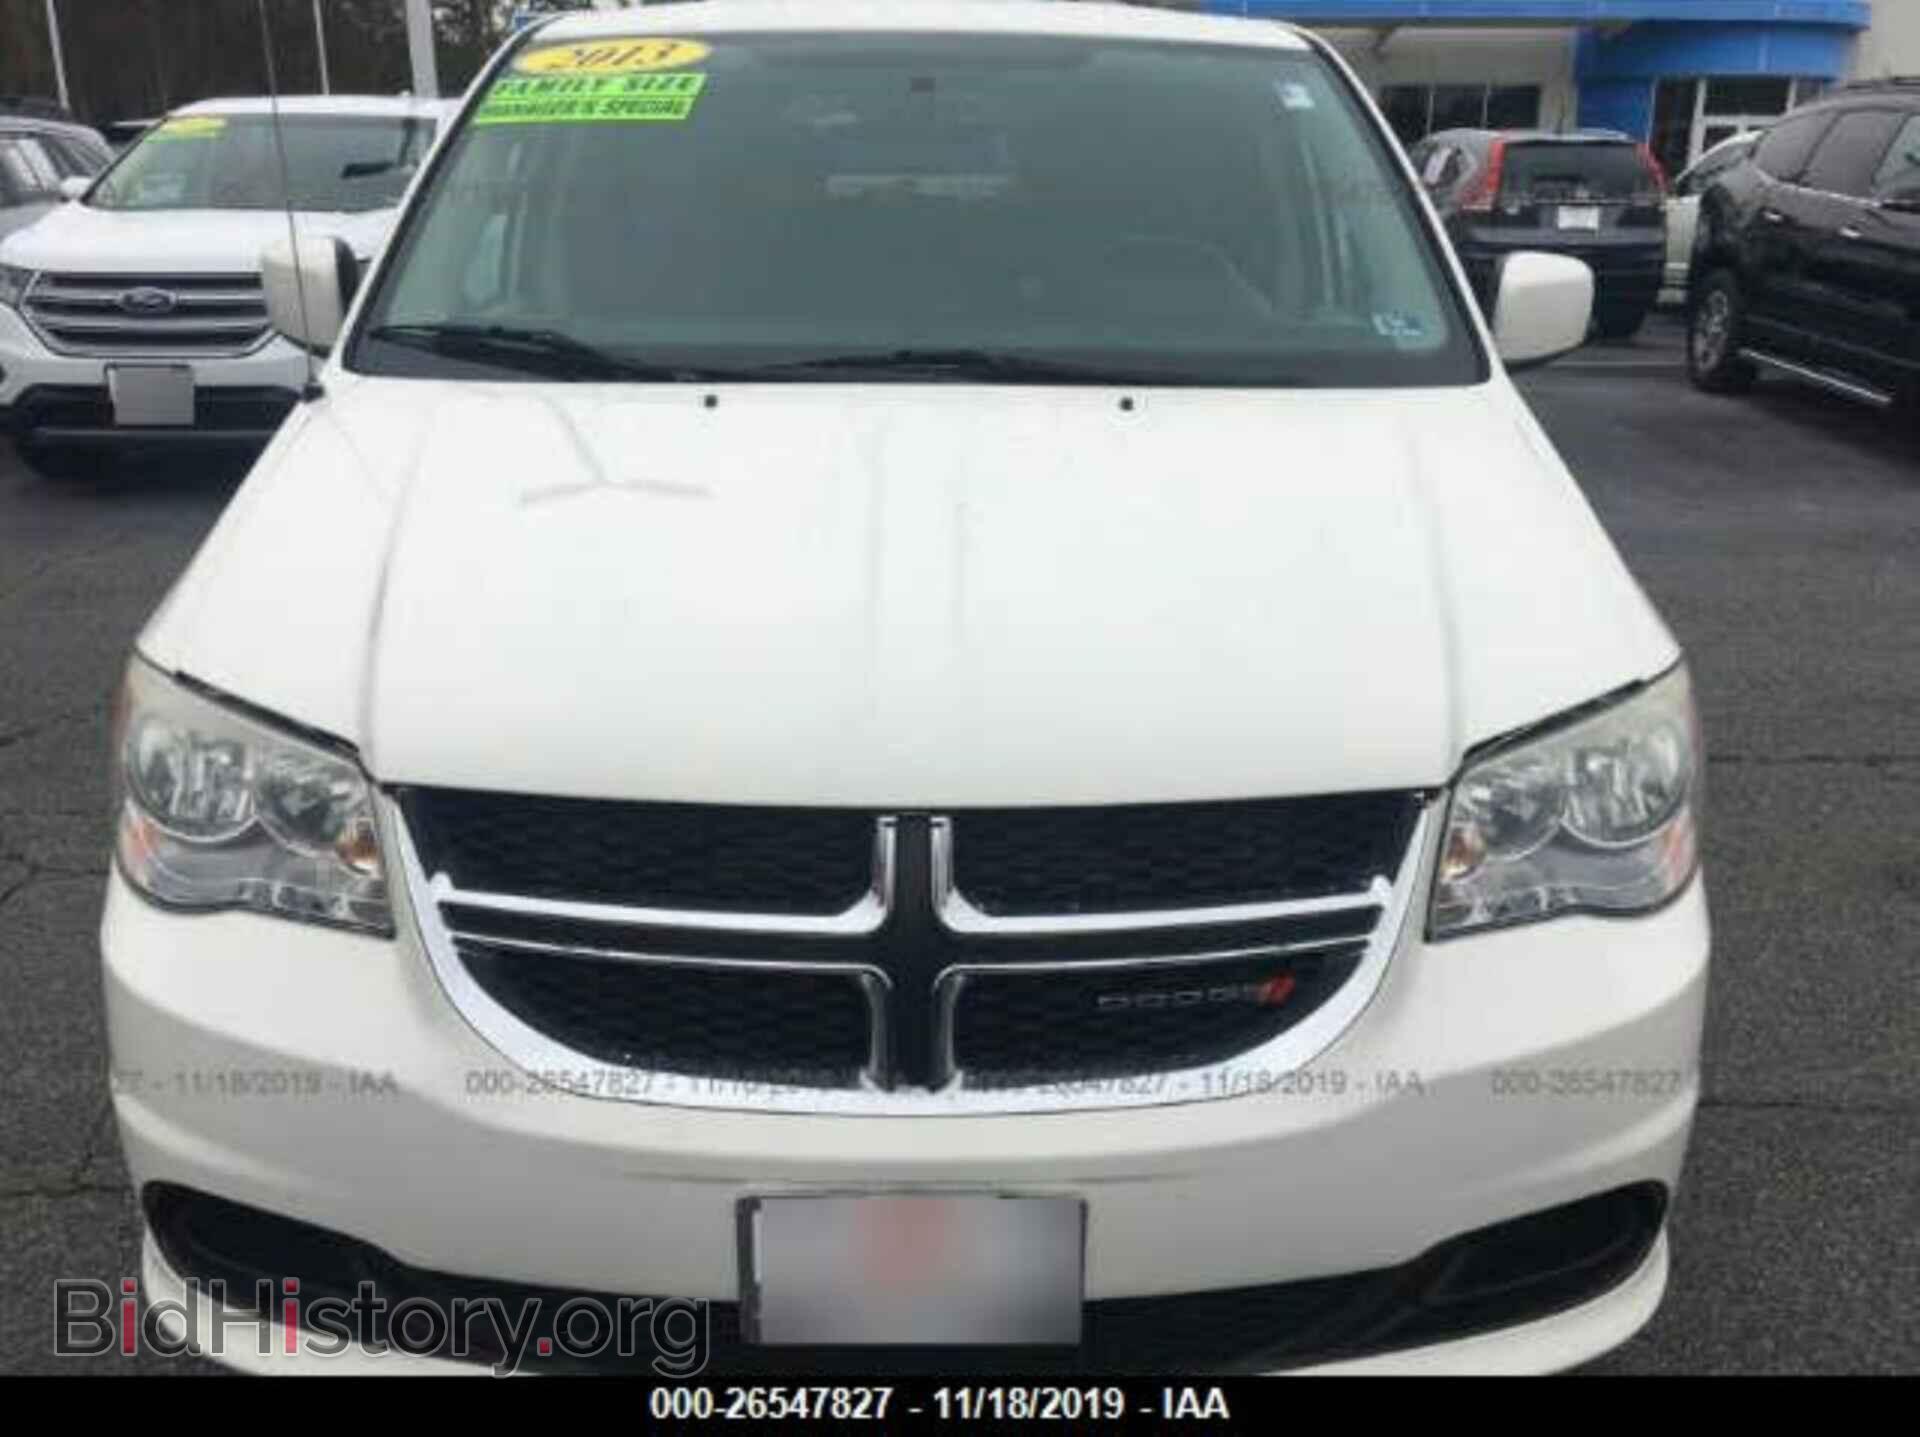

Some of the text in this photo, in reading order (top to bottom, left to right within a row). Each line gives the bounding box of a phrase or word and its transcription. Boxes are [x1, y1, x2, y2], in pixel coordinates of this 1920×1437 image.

[492, 76, 696, 97] FAMILY SIZE
[599, 98, 687, 116] SPECIAL
